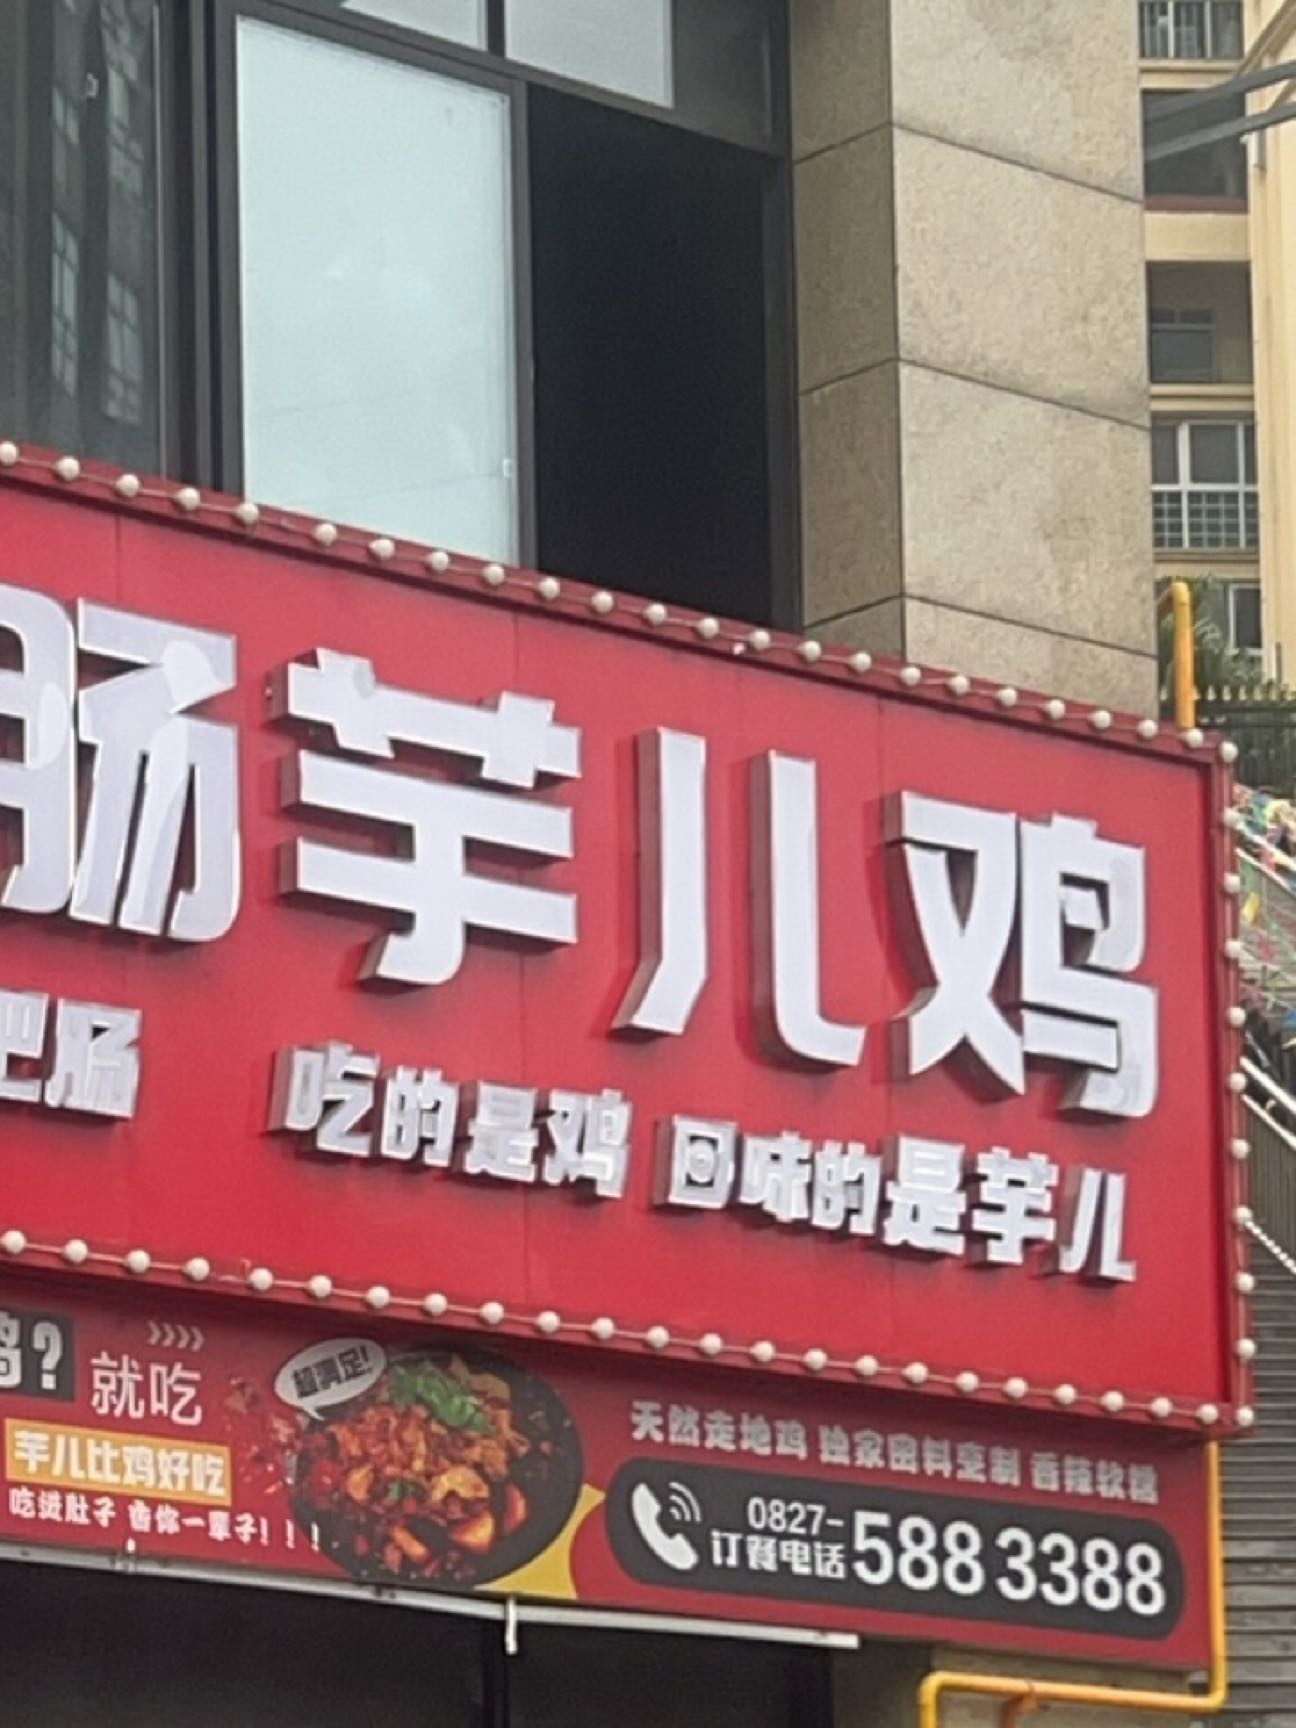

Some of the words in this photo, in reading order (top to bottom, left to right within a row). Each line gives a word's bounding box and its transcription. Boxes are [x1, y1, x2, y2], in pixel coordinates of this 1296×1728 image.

[270, 1041, 633, 1200] 吃的是鸡
[655, 1113, 1137, 1283] 回味的是芋儿
[90, 1352, 202, 1426] 就吃
[14, 1429, 228, 1496] 芋儿比鸡好吃
[632, 1400, 807, 1460] 天然走地鸡
[710, 1529, 846, 1580] 订餐电话
